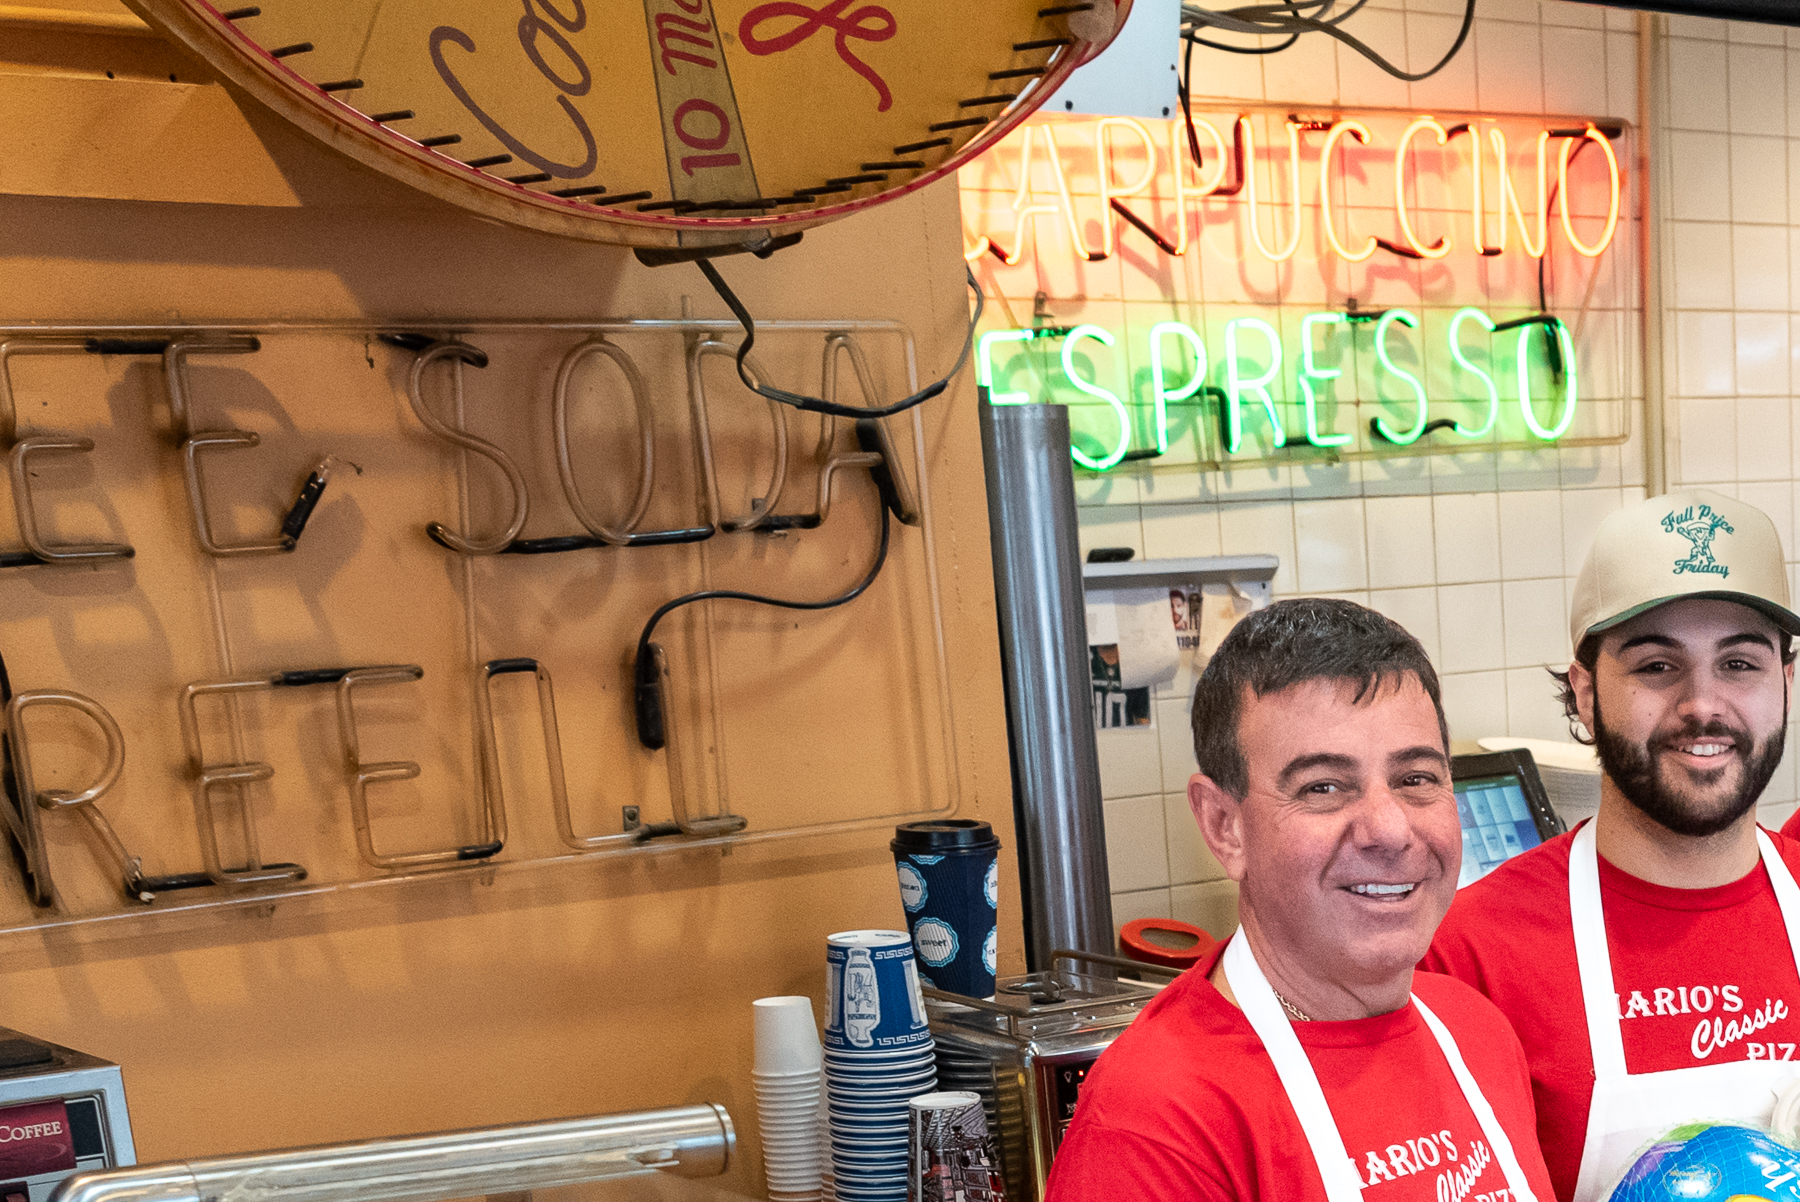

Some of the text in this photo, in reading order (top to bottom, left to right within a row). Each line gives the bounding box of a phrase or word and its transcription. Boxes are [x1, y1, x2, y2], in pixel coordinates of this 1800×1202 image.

[963, 116, 1622, 266] APPUCCINO
[408, 331, 920, 554] SODA
[1660, 504, 1735, 535] Full Price
[1672, 558, 1730, 579] Friday
[1690, 997, 1790, 1060] Classic
